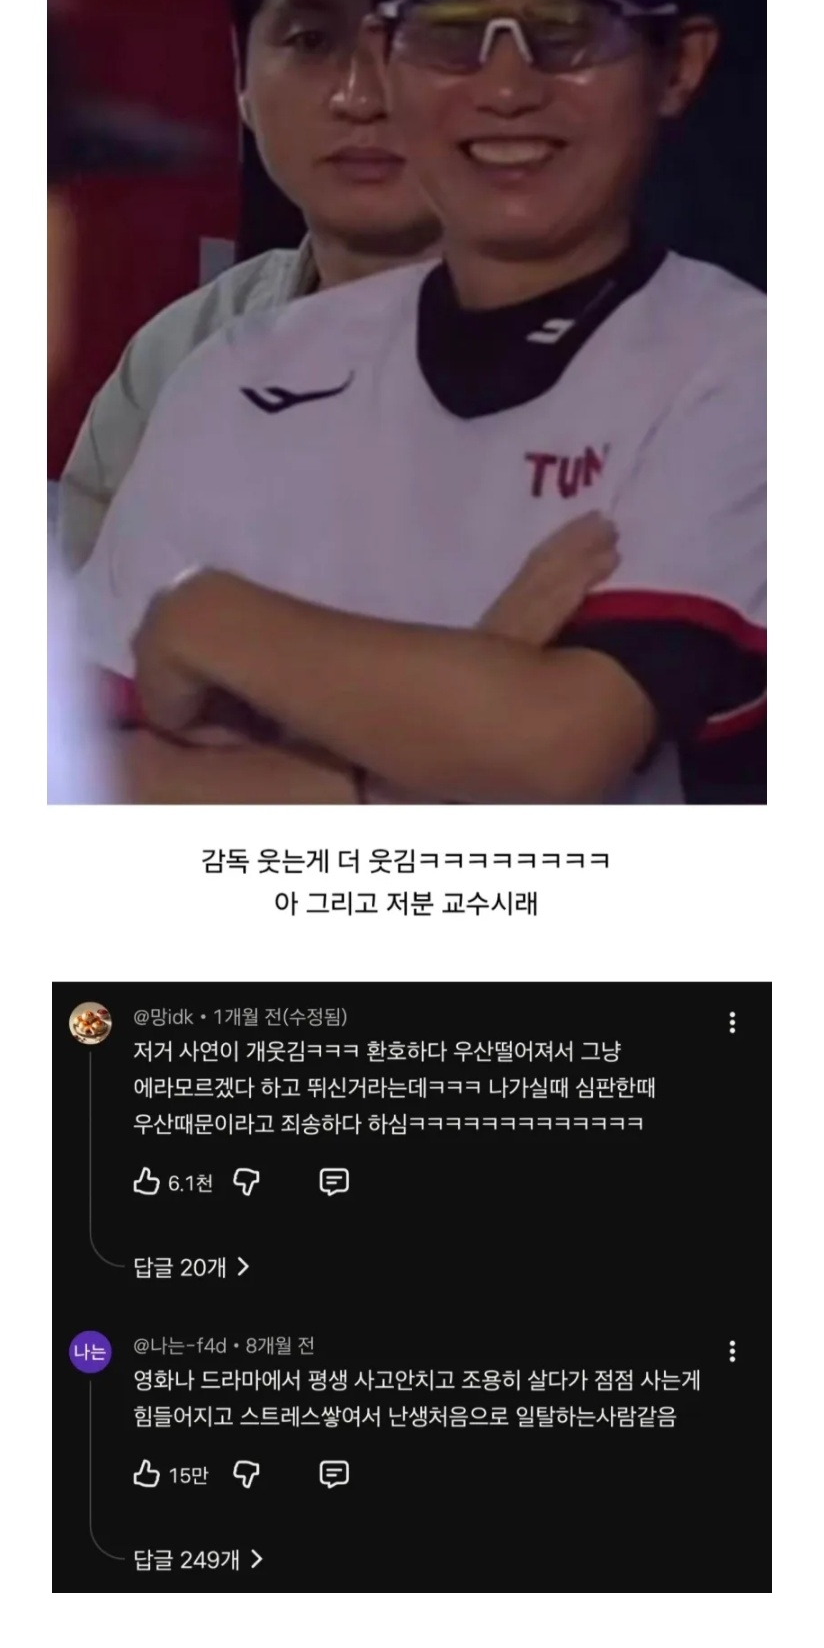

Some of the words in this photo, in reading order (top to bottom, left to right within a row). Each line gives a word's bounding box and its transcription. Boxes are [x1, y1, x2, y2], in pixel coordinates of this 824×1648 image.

[133, 1007, 194, 1027] @망idk
[213, 1007, 258, 1027] 1개월
[264, 1007, 347, 1027] 전(수정됨)
[133, 1040, 172, 1063] 저거
[178, 1040, 239, 1063] 사연이
[246, 1040, 359, 1063] 개웃김ㅋㅋㅋ
[366, 1040, 448, 1063] 환호하다
[453, 1040, 573, 1063] 우산떨어져서
[580, 1040, 622, 1063] 그냥
[133, 1076, 256, 1099] 에라모르겠다
[260, 1076, 301, 1099] 하고
[307, 1076, 481, 1099] 뛰신거라는데ㅋㅋㅋ
[489, 1076, 569, 1099] 나가실때
[575, 1076, 656, 1099] 심판한때
[133, 1112, 275, 1136] 우산때문이라고
[280, 1112, 363, 1136] 죄송하다
[367, 1112, 643, 1136] 하심ㅋㅋㅋㅋㅋㅋㅋㅋㅋㅋㅋㅋㅋ
[168, 1173, 213, 1193] 6.1천
[134, 1256, 174, 1279] 답글
[180, 1256, 226, 1279] 20개
[74, 1343, 107, 1361] 나는
[133, 1336, 227, 1355] @나는-f4d
[245, 1336, 291, 1356] 8개월
[298, 1336, 314, 1355] 전
[133, 1368, 195, 1392] 영화나
[200, 1368, 301, 1392] 드라마에서
[308, 1368, 348, 1392] 평생
[353, 1368, 456, 1392] 사고안치고
[461, 1369, 521, 1392] 조용히
[527, 1368, 589, 1392] 살다가
[594, 1368, 633, 1392] 점점
[640, 1368, 700, 1392] 사는게
[133, 1405, 234, 1428] 힘들어지고
[239, 1405, 381, 1429] 스트레스쌓여서
[388, 1405, 510, 1428] 난생처음으로
[515, 1405, 677, 1428] 일탈하는사람같음
[169, 1466, 210, 1486] 15만
[134, 1548, 174, 1572] 답글
[180, 1548, 240, 1572] 249개
